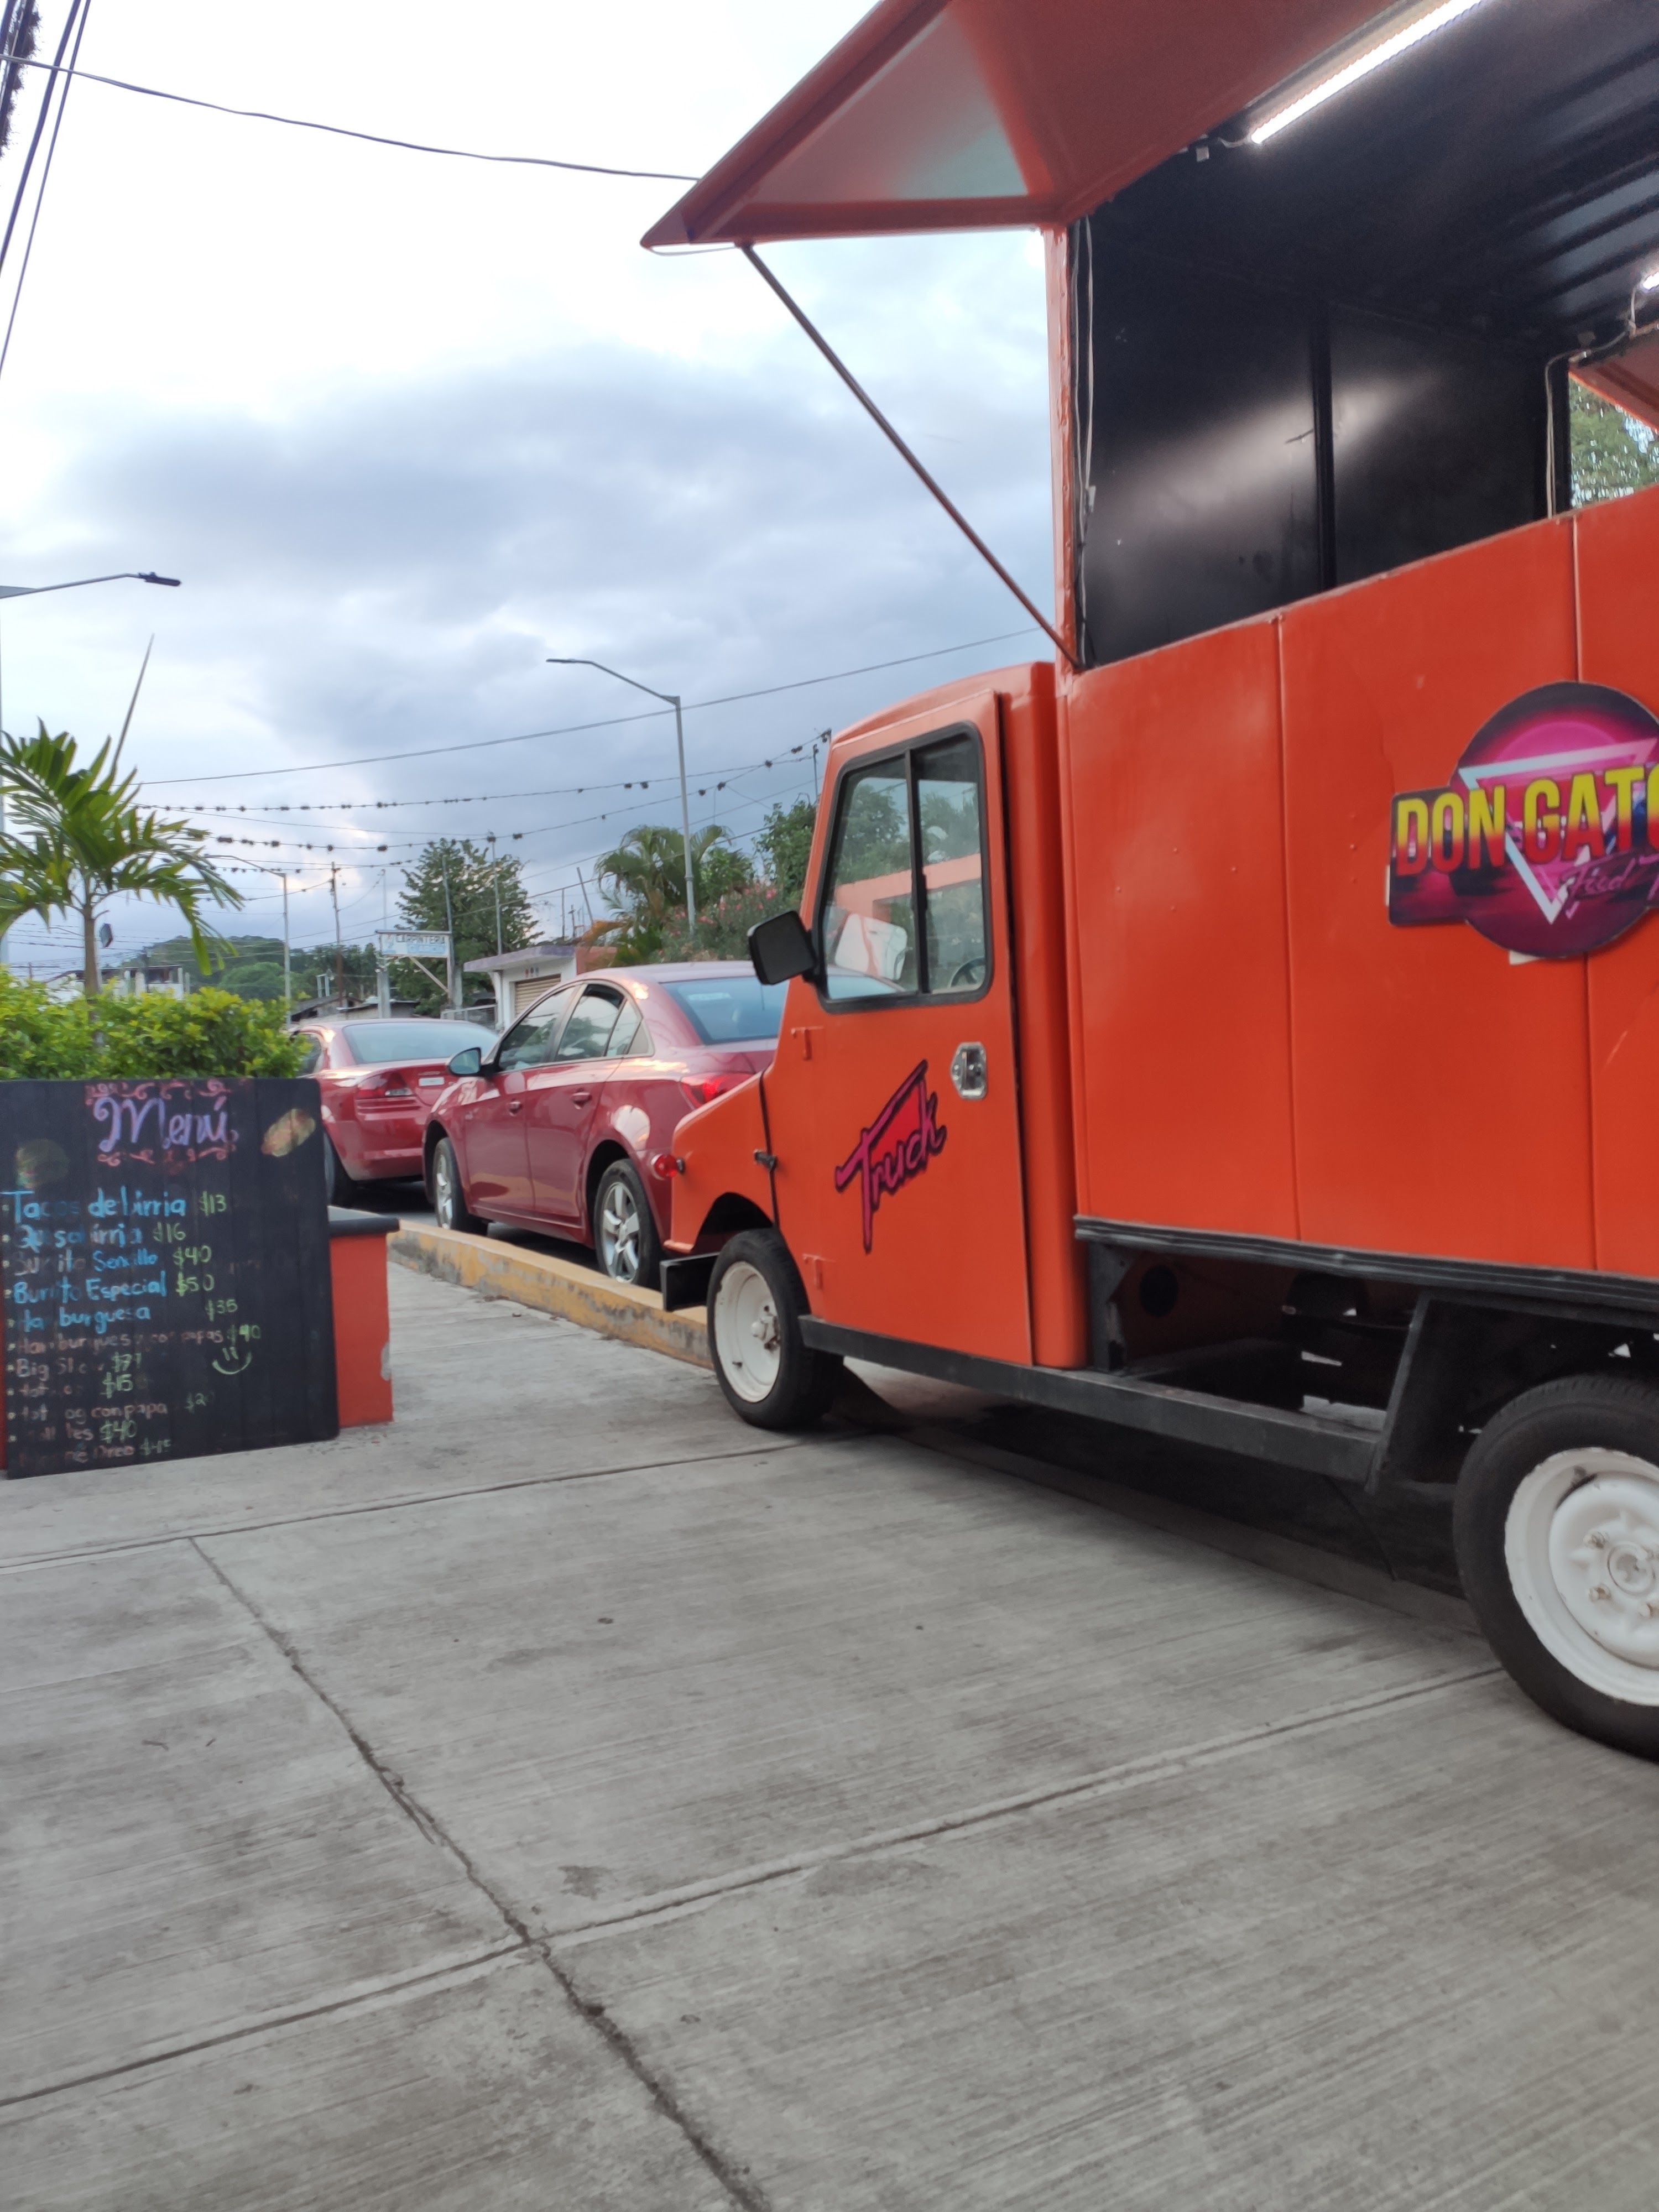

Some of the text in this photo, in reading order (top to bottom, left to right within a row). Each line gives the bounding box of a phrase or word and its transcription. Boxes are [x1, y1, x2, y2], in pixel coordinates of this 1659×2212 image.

[1396, 785, 1506, 877] DON
[93, 1095, 229, 1152] Menú
[836, 1059, 947, 1255] Truck
[199, 1190, 227, 1216] $13
[153, 1221, 186, 1243] $16
[86, 1270, 166, 1301] Especial
[175, 1271, 215, 1297] $50
[18, 1306, 151, 1334] Haburguesa
[17, 1358, 50, 1382] Big
